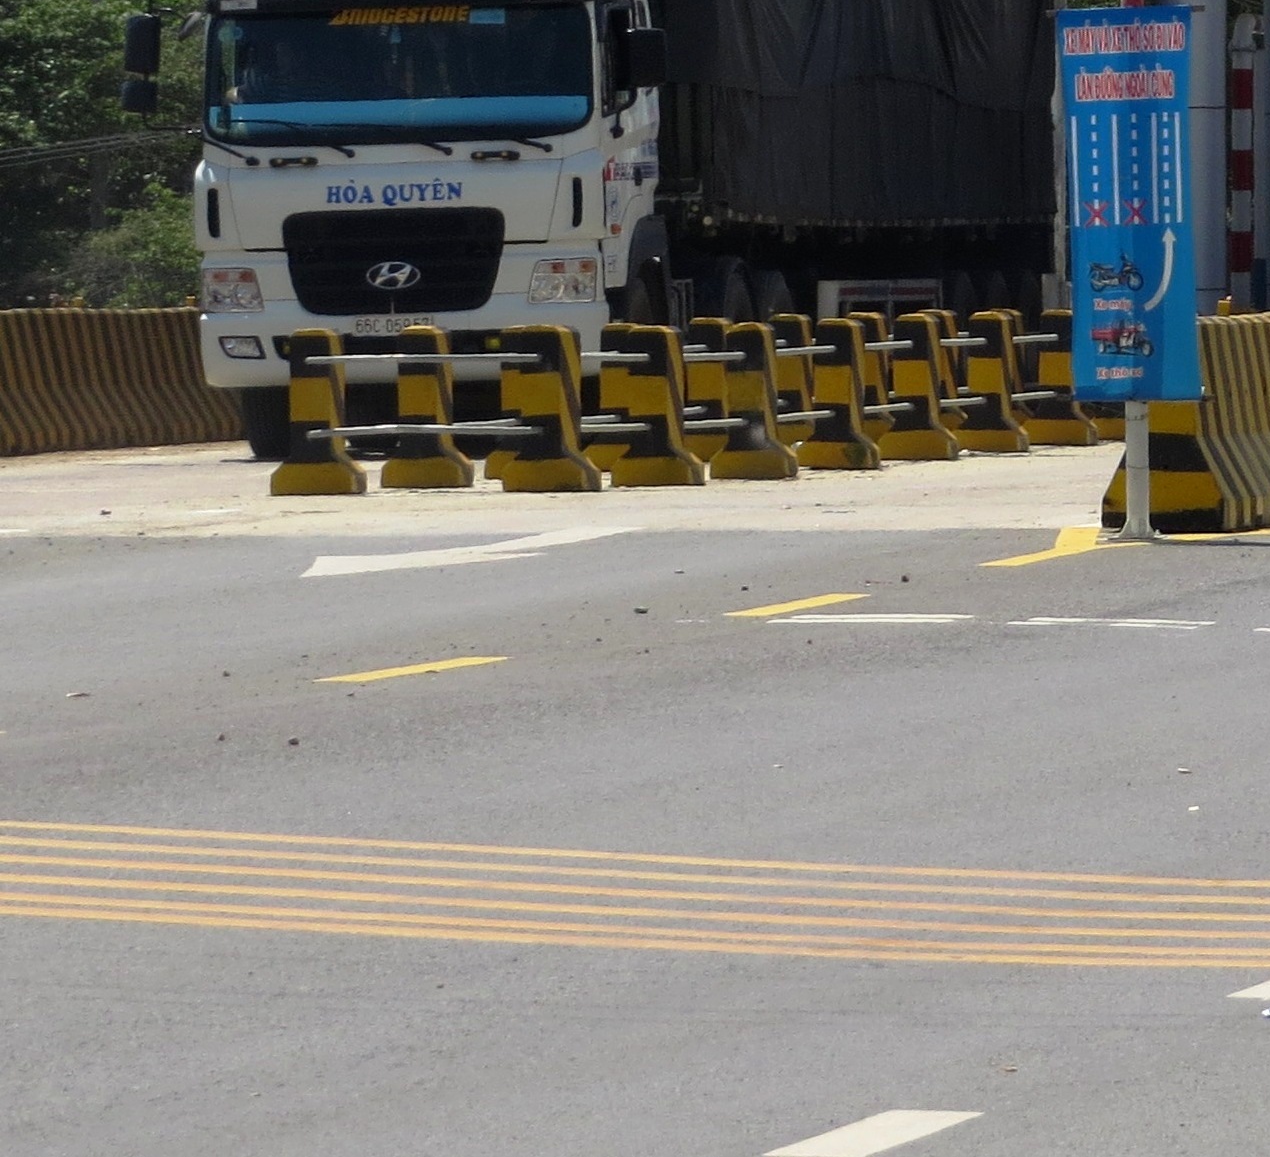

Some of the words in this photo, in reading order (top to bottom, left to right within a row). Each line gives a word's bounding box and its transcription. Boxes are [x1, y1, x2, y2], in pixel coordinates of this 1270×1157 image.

[328, 4, 469, 26] BRIDGESTONE
[326, 179, 374, 203] HÒA
[382, 177, 462, 206] QUYÊN
